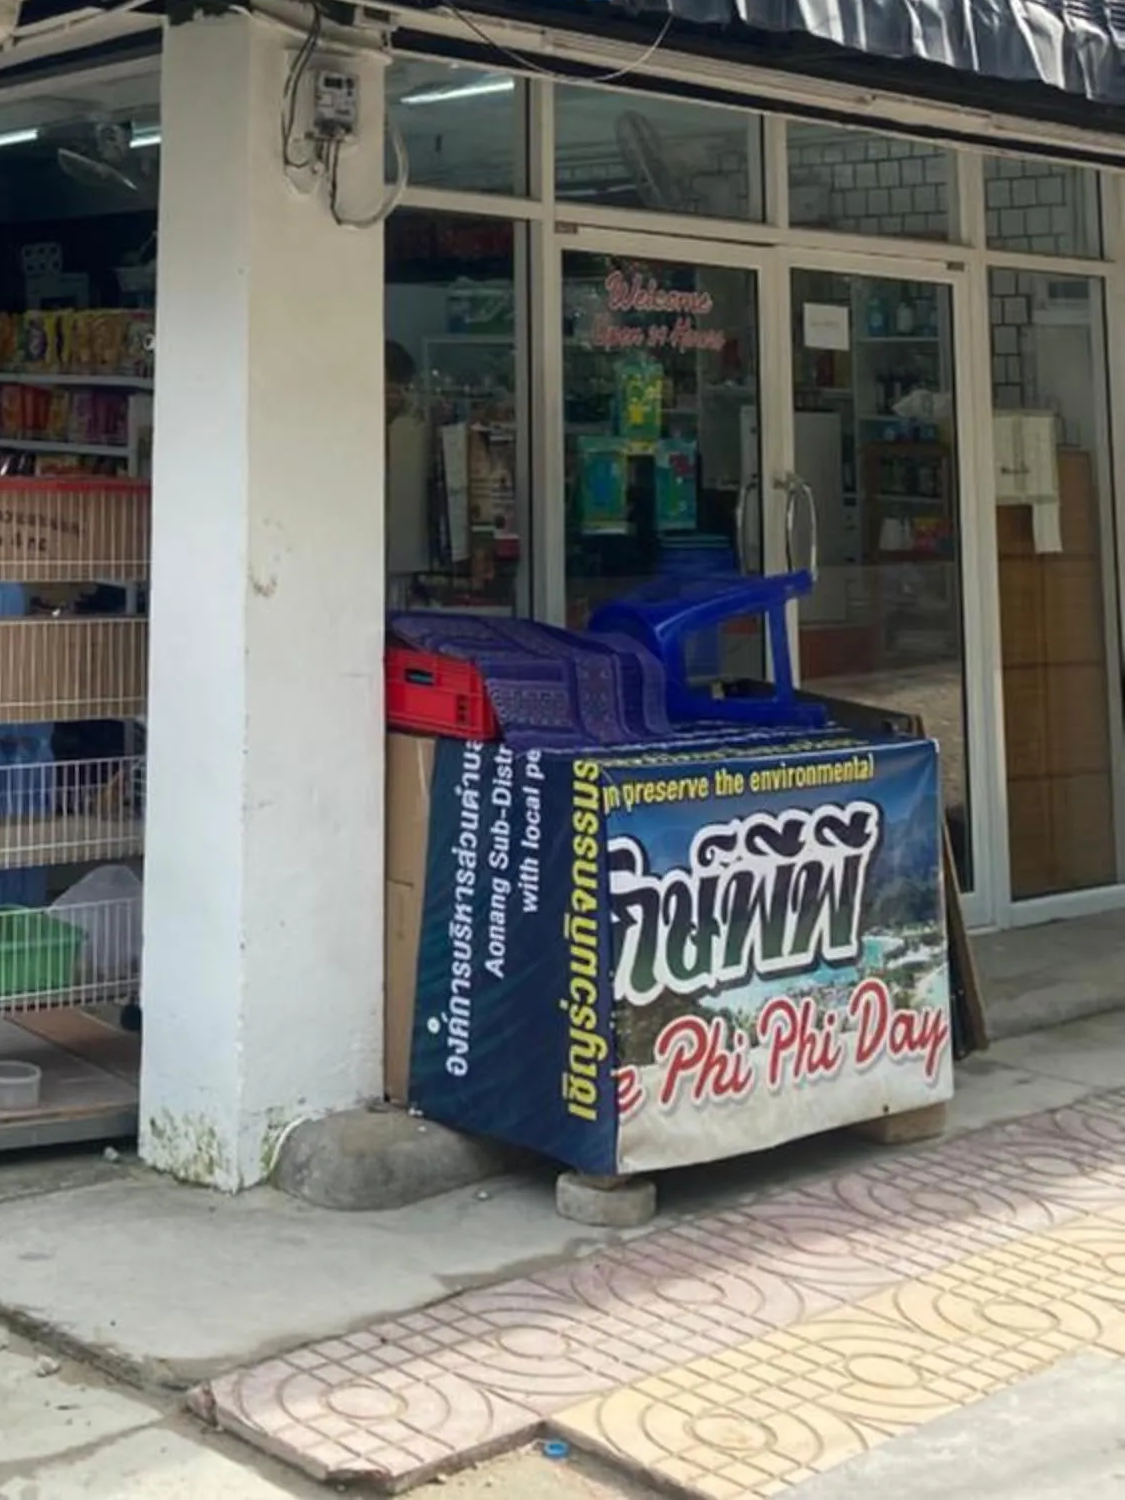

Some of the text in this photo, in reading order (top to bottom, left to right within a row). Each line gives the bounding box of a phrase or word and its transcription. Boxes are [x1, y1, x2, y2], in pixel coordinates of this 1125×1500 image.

[604, 269, 714, 314] Welcome
[622, 776, 709, 813] preserve
[714, 768, 744, 796] the
[749, 753, 875, 793] environmental
[520, 786, 542, 849] local
[517, 857, 540, 913] with
[484, 877, 512, 979] Aonang
[655, 1015, 754, 1106] Phi
[759, 997, 842, 1088] Phi
[850, 977, 949, 1081] Day
